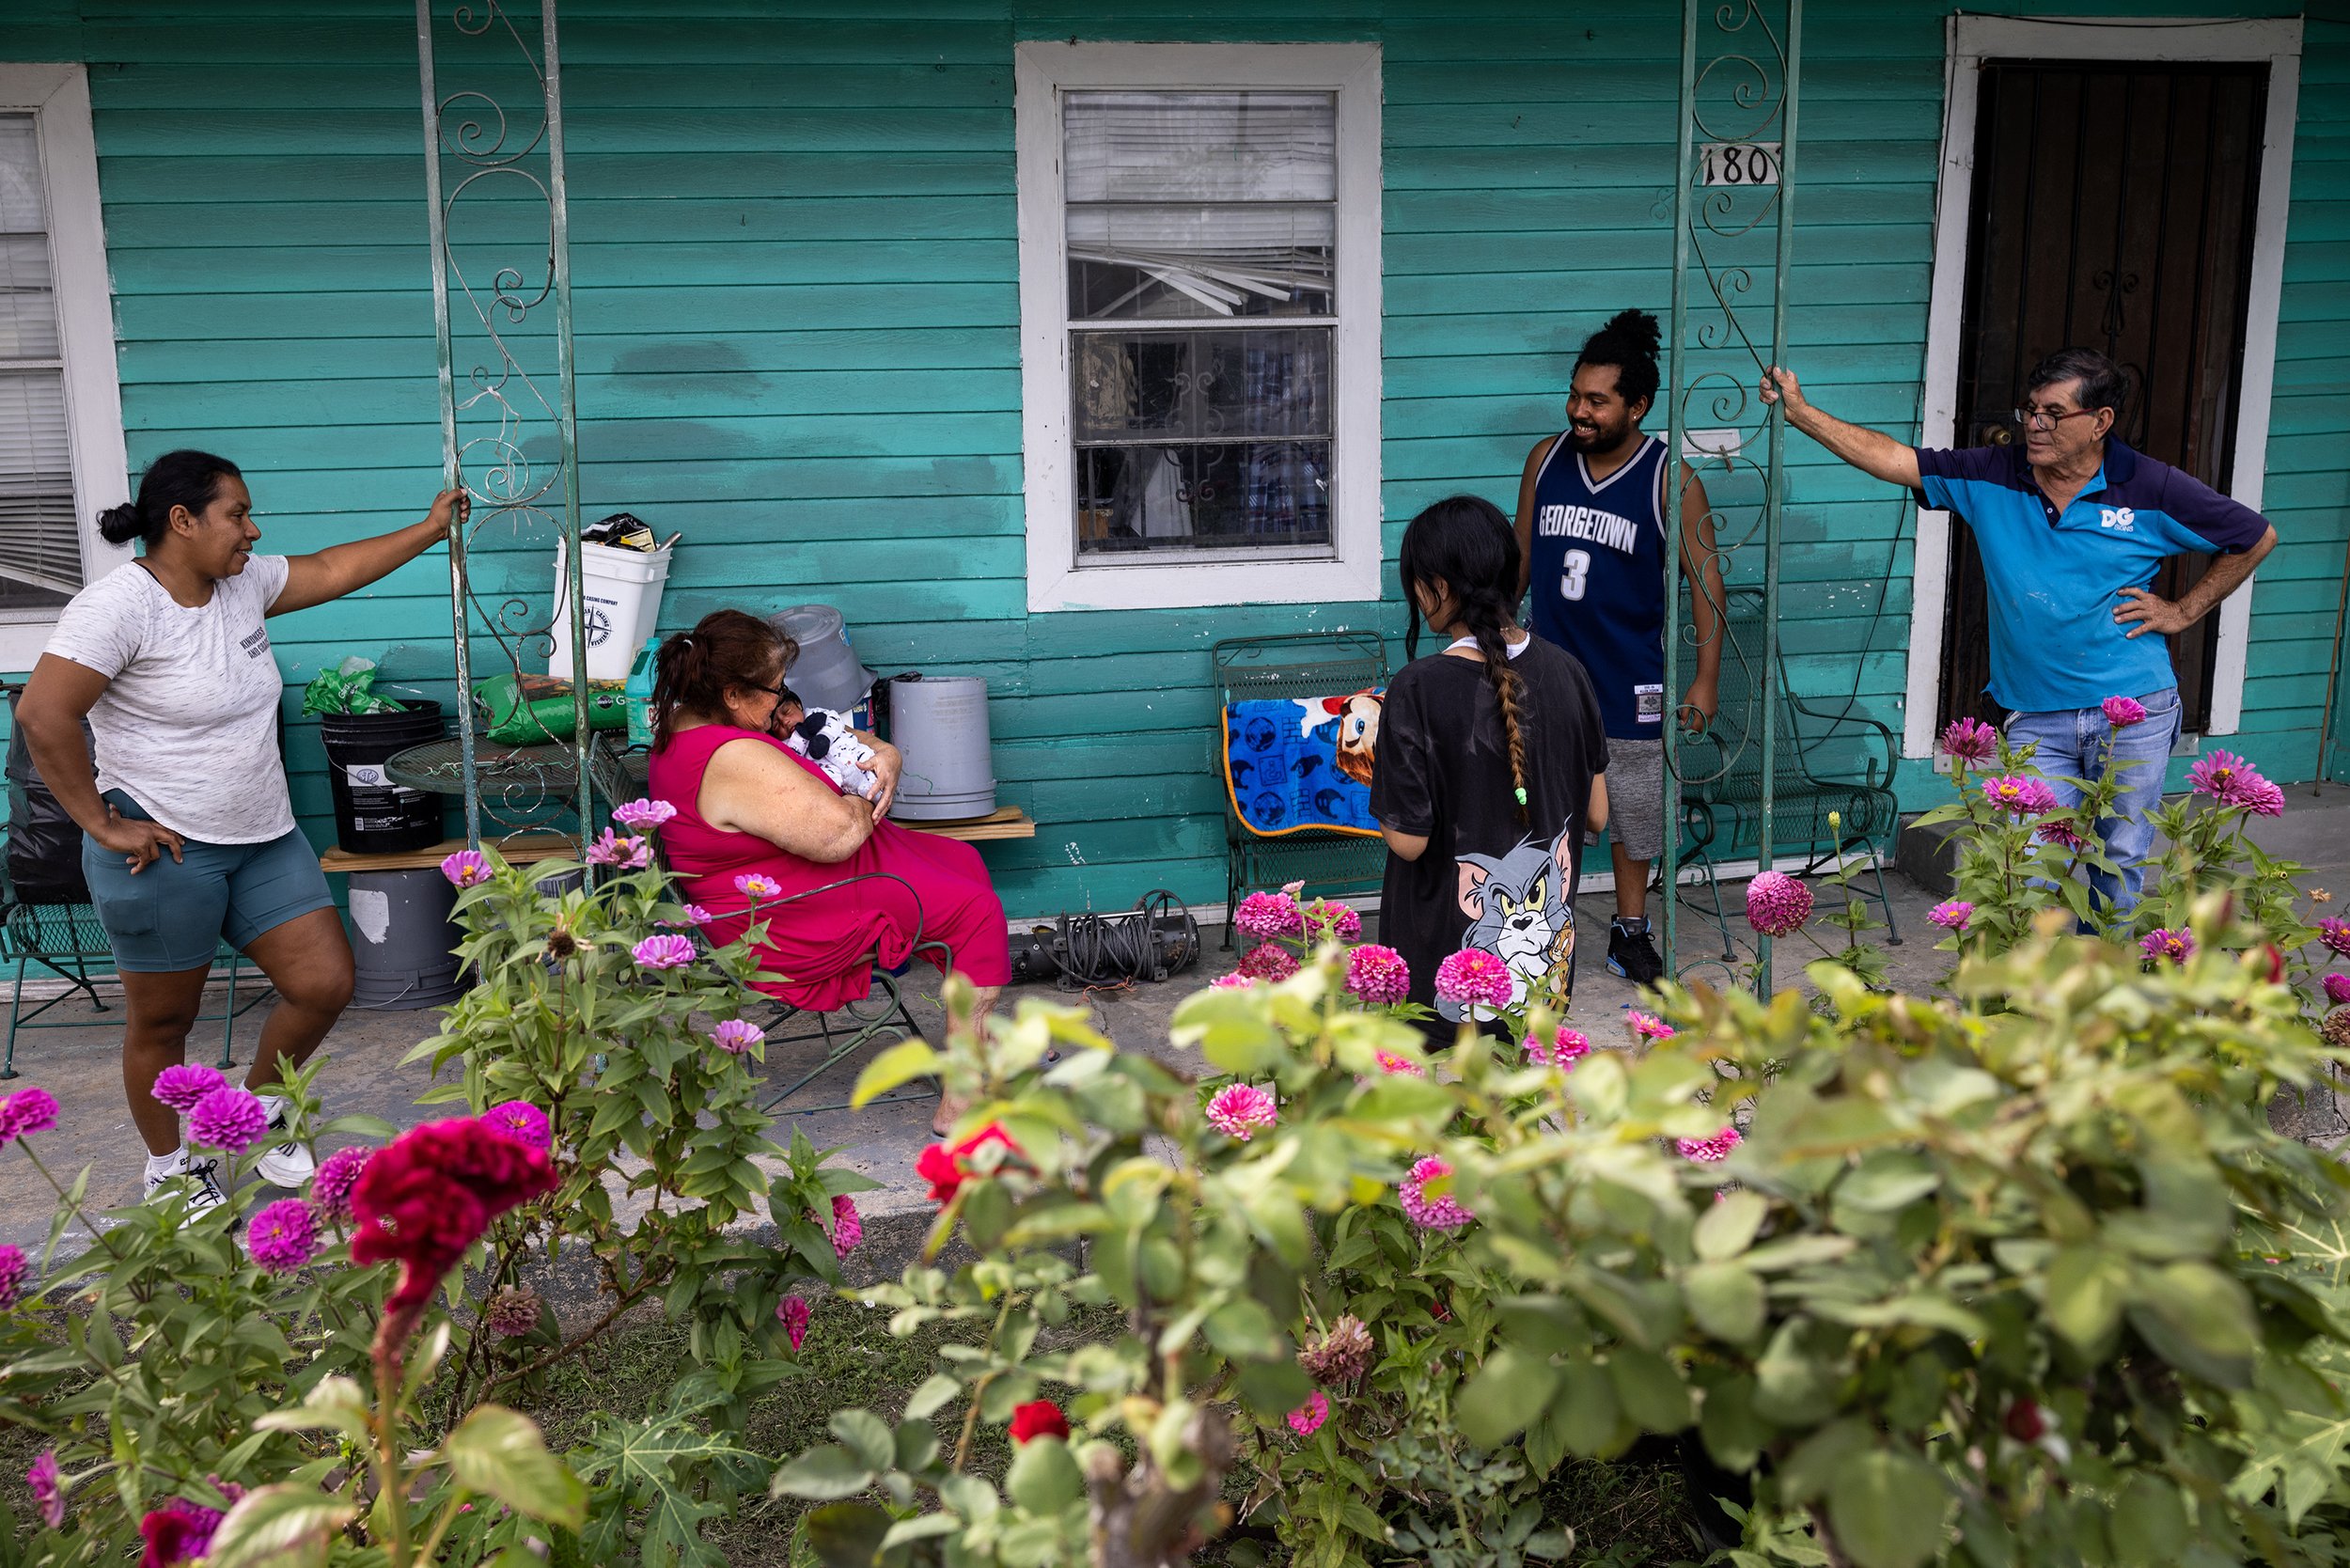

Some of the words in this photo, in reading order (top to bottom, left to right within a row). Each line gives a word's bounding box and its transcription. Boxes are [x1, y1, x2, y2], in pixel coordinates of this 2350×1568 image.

[1705, 147, 1782, 186] 180
[2101, 507, 2134, 527] DG
[1539, 505, 1637, 555] GEORGETOWN
[1560, 548, 1590, 601] 3
[586, 595, 600, 604] CASING
[601, 598, 618, 606] COMPANY
[595, 610, 609, 627] CASING
[240, 626, 265, 650] KINDNESS
[247, 647, 260, 659] AND
